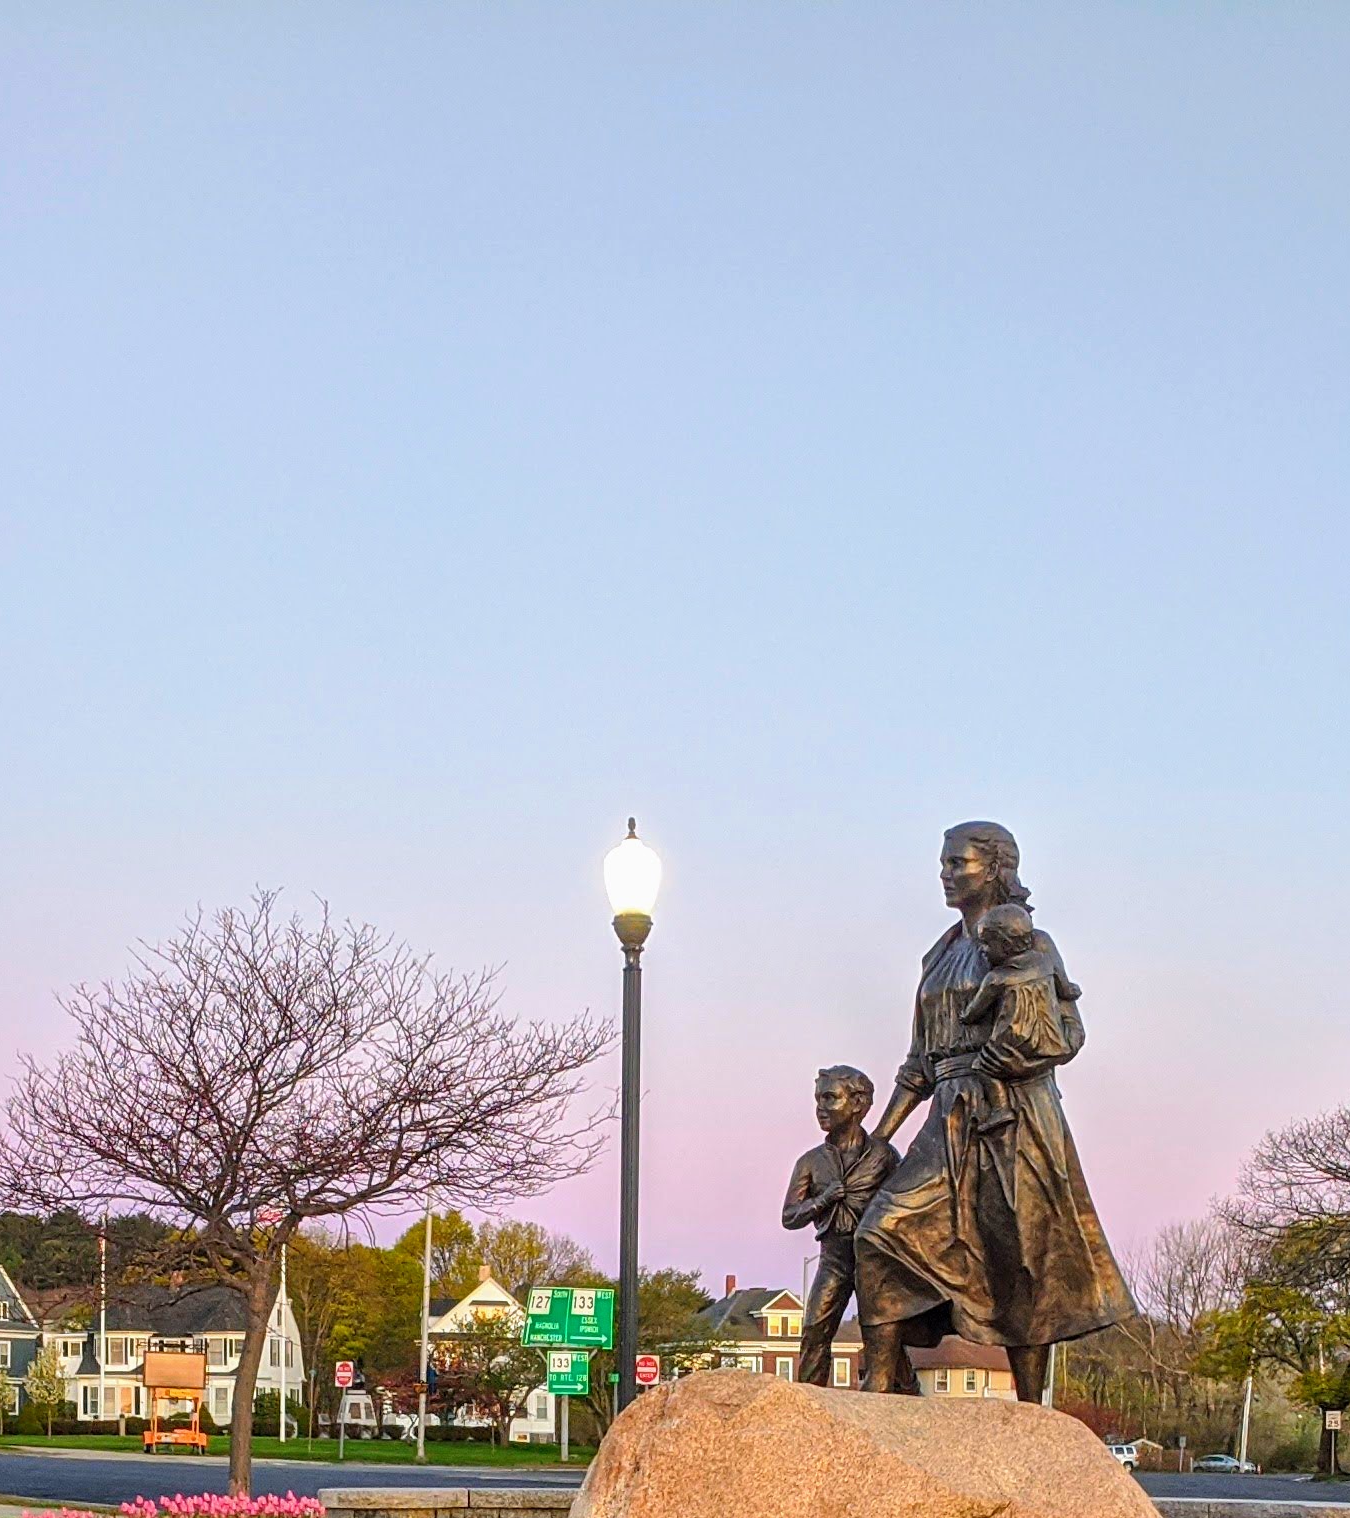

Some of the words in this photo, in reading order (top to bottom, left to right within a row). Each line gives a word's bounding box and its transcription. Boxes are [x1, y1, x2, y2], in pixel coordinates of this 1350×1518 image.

[596, 1291, 612, 1299] WEST
[531, 1296, 551, 1309] 127
[573, 1296, 594, 1309] 133
[581, 1316, 598, 1324] ESSEX
[530, 1334, 563, 1342] MANCHESTER
[572, 1354, 588, 1362] WEST
[552, 1358, 570, 1368] 133
[549, 1374, 557, 1382] TO
[576, 1374, 588, 1382] 128
